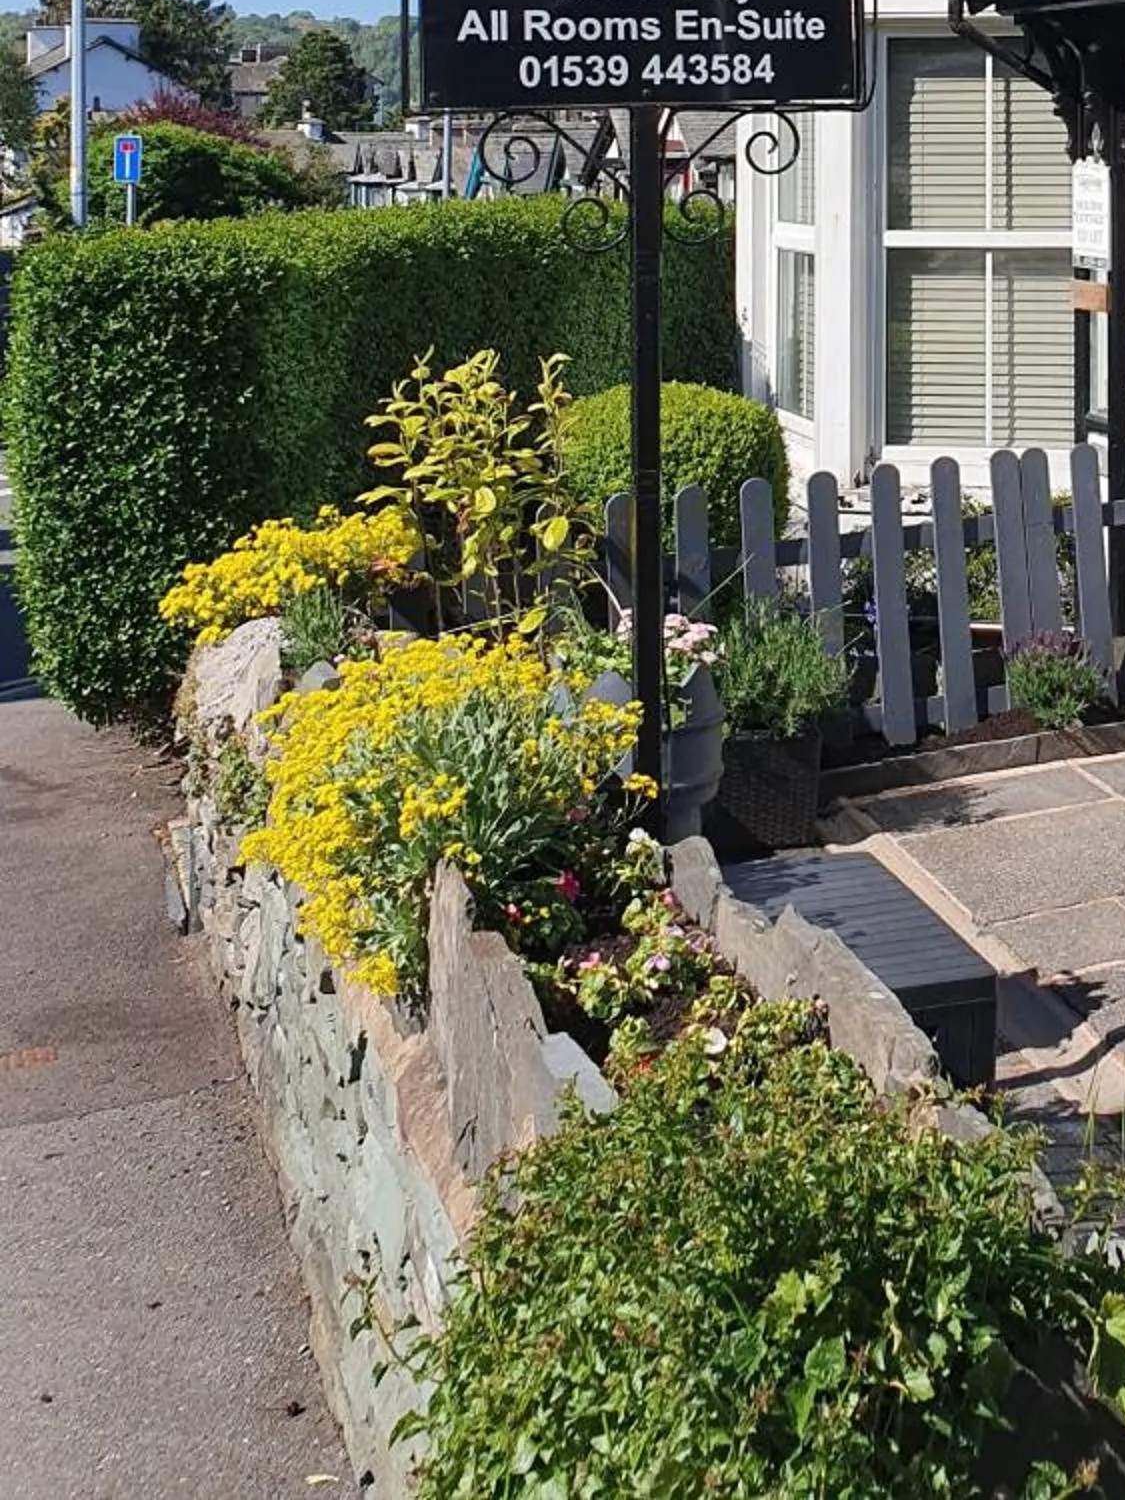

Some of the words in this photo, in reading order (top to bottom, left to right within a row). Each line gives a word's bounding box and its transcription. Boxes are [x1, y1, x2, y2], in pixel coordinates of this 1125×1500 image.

[457, 9, 509, 42] All
[524, 10, 661, 42] Rooms
[675, 10, 827, 41] En-Suite
[519, 55, 629, 88] 01539
[641, 54, 776, 86] 443584
